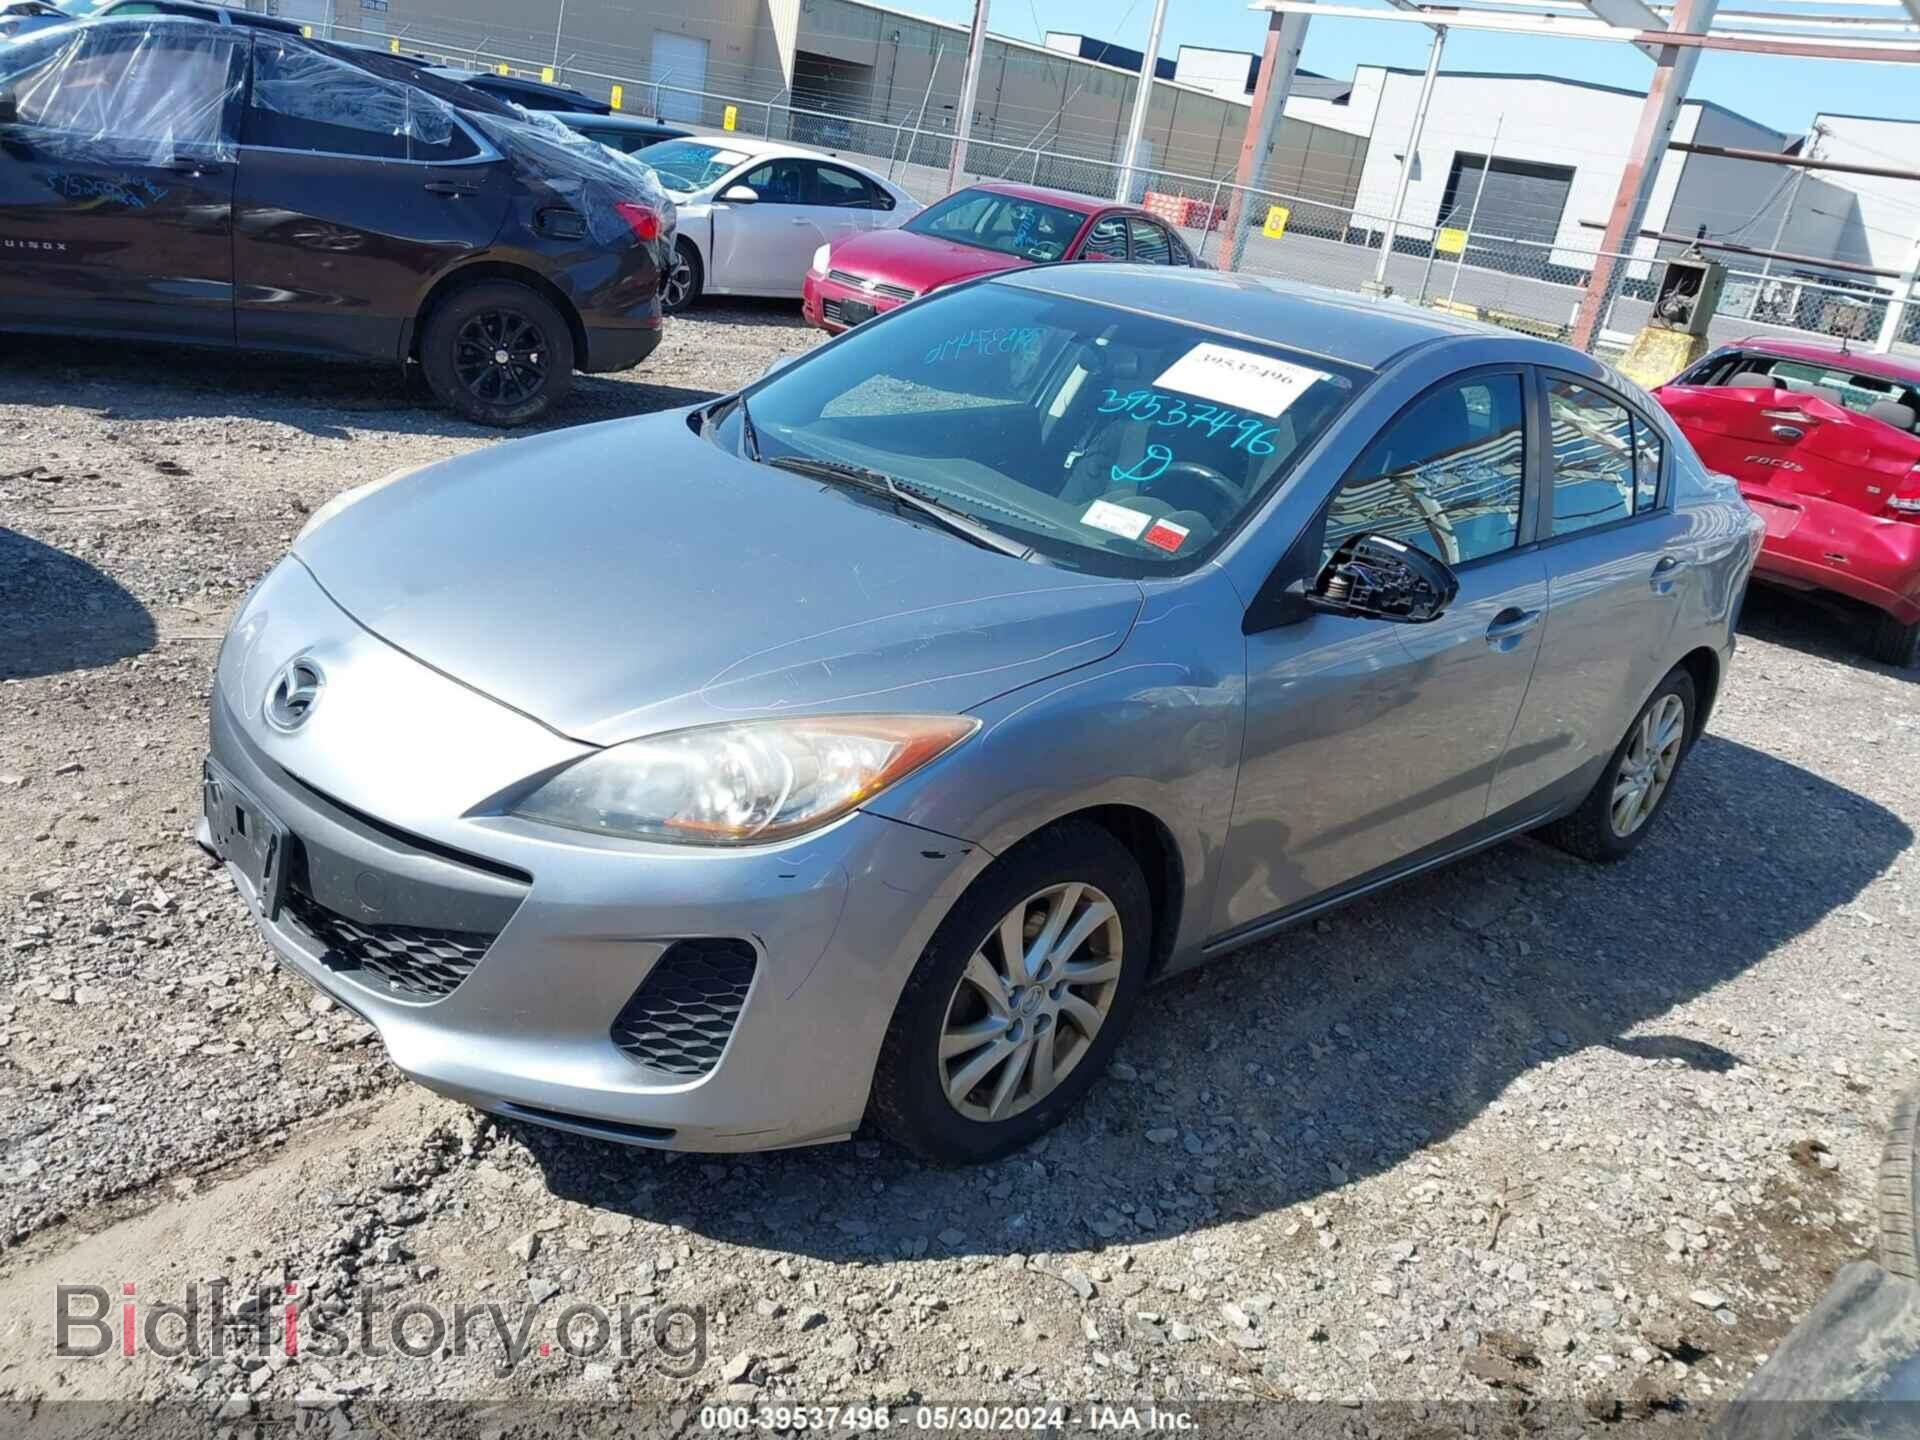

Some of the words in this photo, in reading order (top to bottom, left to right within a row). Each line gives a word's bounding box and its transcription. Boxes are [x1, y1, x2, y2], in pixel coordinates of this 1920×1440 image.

[0, 239, 67, 250] UINOX
[1097, 388, 1281, 455] 39537496
[1744, 455, 1805, 472] FOCUS
